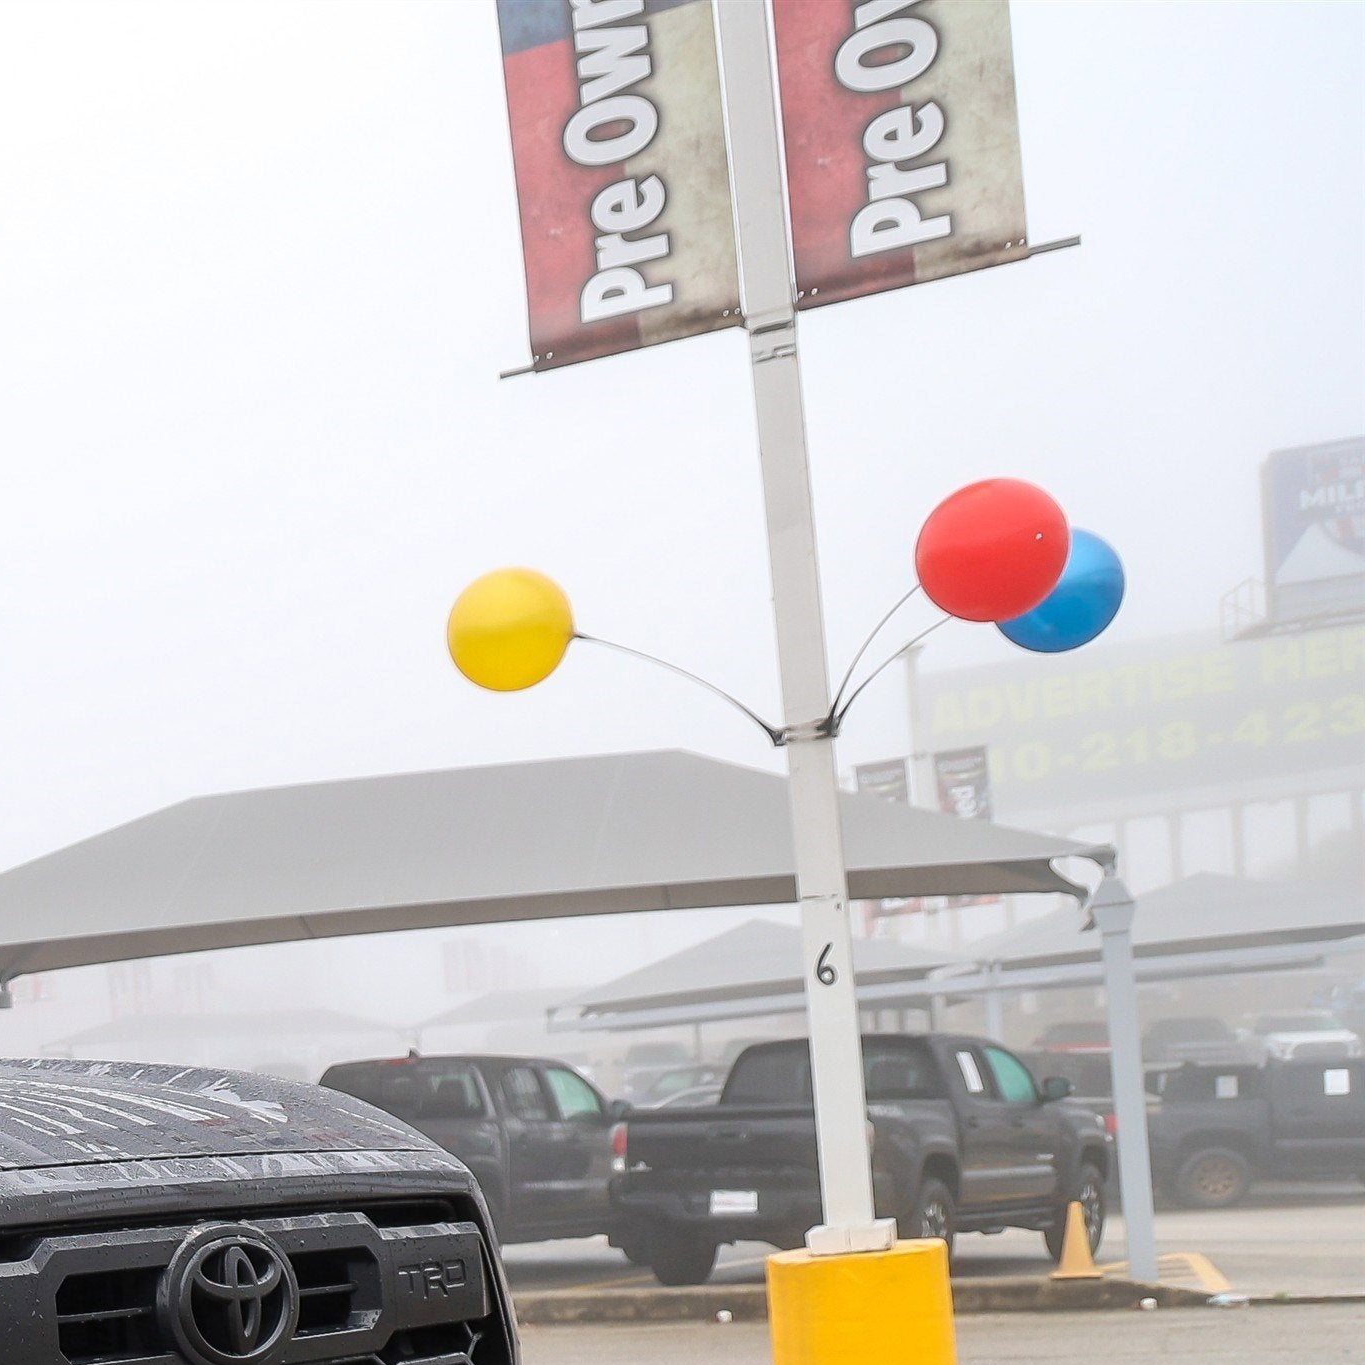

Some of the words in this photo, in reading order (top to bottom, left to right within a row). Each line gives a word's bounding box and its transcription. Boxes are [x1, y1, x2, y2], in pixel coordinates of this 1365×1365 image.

[835, 0, 938, 93] O
[850, 101, 952, 258] Pre
[580, 174, 673, 323] Pre
[934, 645, 1236, 728] ADVERTISE
[816, 942, 836, 985] 6
[398, 1257, 467, 1299] TRD
